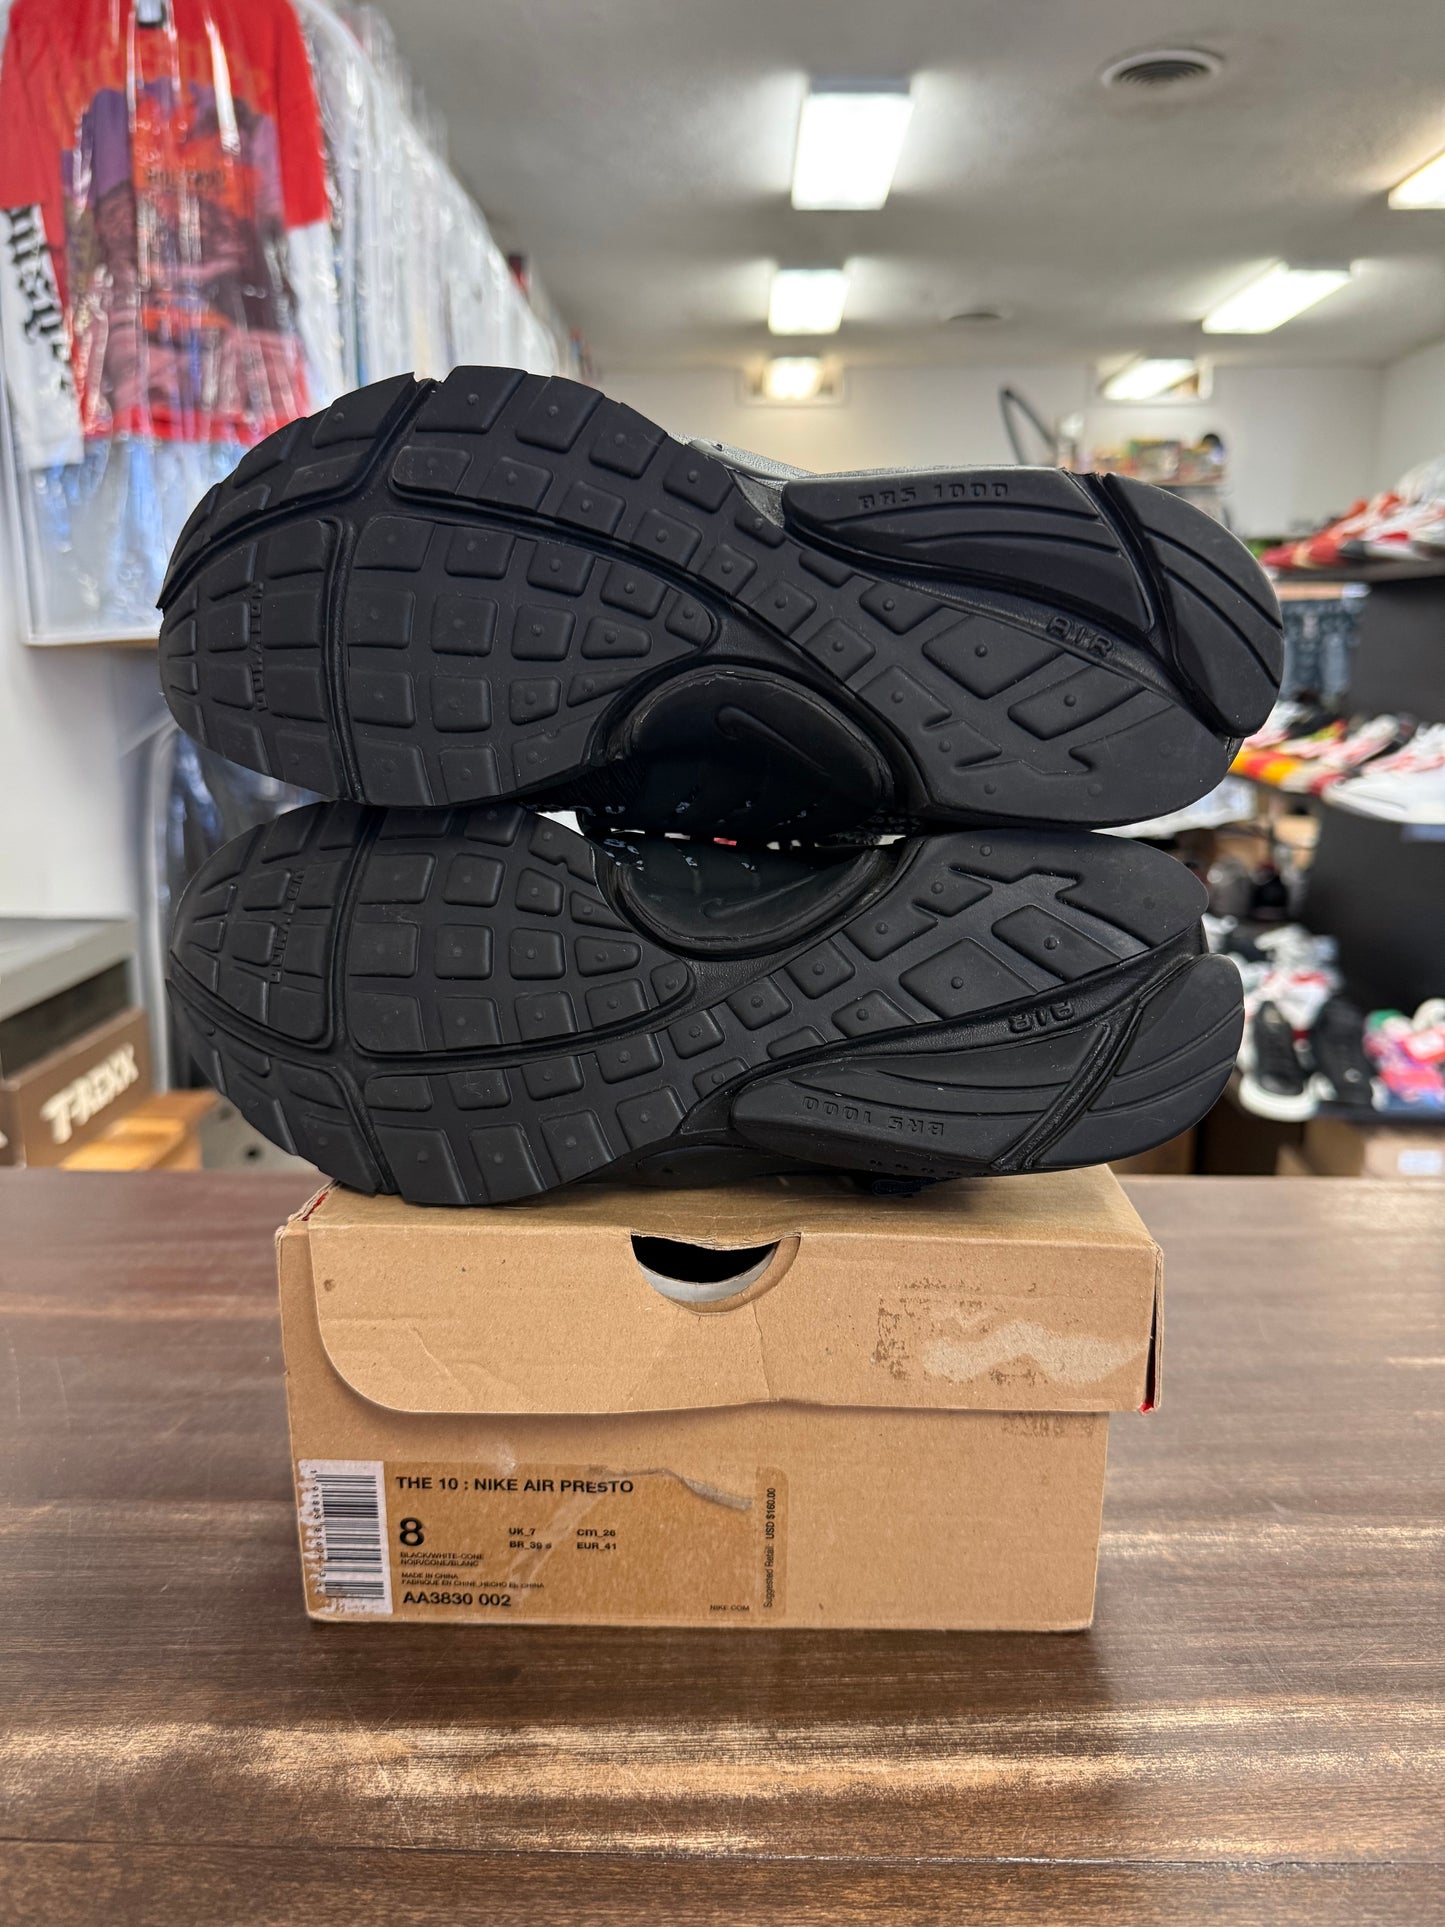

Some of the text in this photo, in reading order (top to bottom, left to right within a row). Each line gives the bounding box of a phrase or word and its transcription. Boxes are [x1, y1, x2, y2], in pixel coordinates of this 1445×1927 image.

[933, 482, 1009, 499] 1000
[1045, 615, 1114, 658] AIR
[1007, 1001, 1075, 1034] AIR
[802, 1095, 945, 1137] BRS 1000
[395, 1476, 433, 1490] THE
[438, 1477, 459, 1491] 10
[474, 1478, 519, 1492] NIKE
[523, 1478, 555, 1492] AIR
[559, 1479, 635, 1494] PRESTO
[766, 1487, 776, 1520] $160.00
[399, 1516, 425, 1547] 8
[508, 1527, 536, 1537] UK_7
[765, 1521, 775, 1540] USD
[576, 1542, 617, 1551] EUR_41
[400, 1559, 479, 1567] NOIR/CONE/BLANC
[763, 1568, 775, 1608] Suggested
[402, 1591, 512, 1607] AA3830 002
